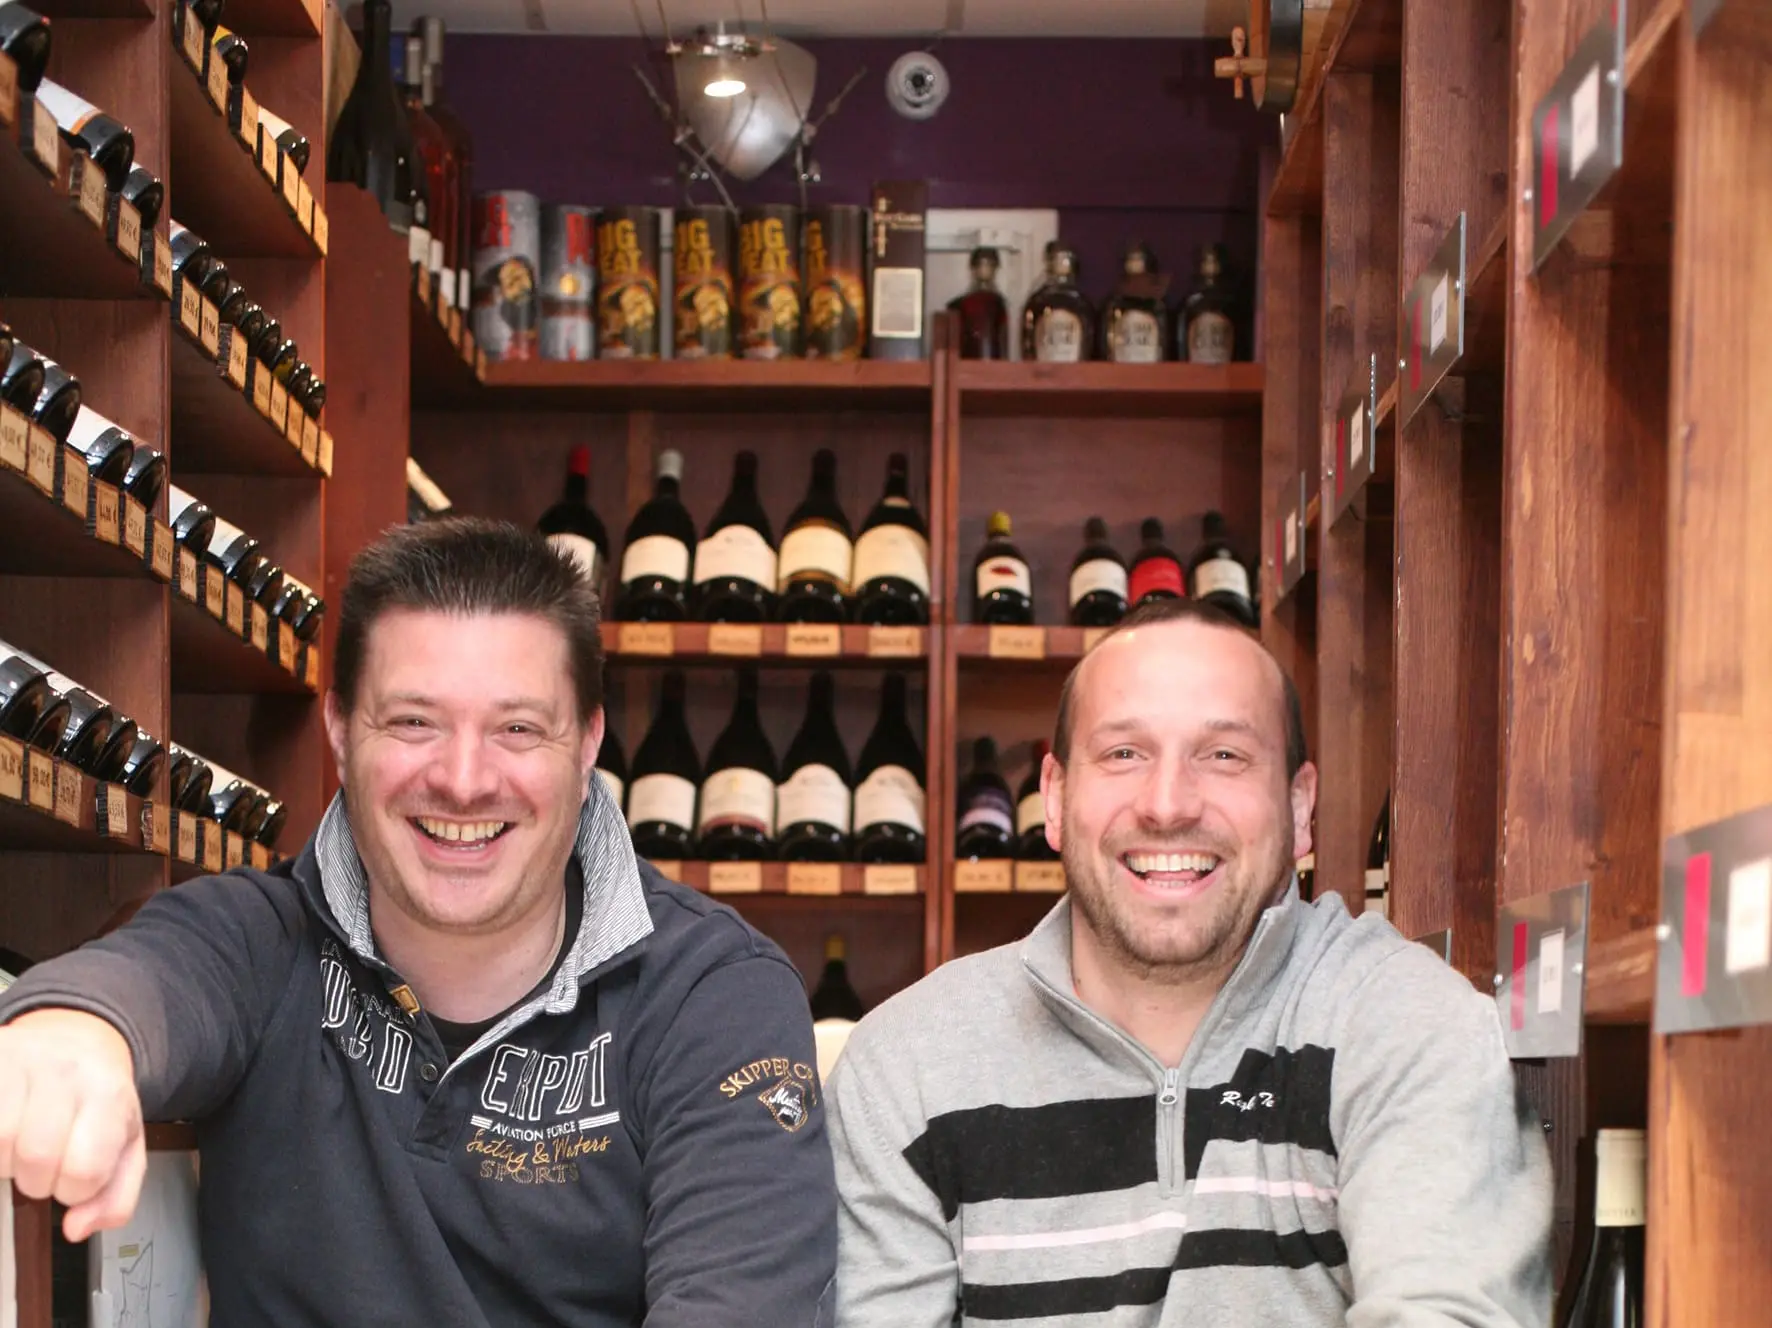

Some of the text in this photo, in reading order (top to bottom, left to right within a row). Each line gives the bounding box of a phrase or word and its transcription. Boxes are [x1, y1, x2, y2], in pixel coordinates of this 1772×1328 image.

[720, 1057, 792, 1098] SKIPPER
[490, 1121, 576, 1141] AVIATION FORCE
[532, 1141, 550, 1164] &
[553, 1134, 611, 1162] Waters
[480, 1159, 580, 1184] SPORTS
